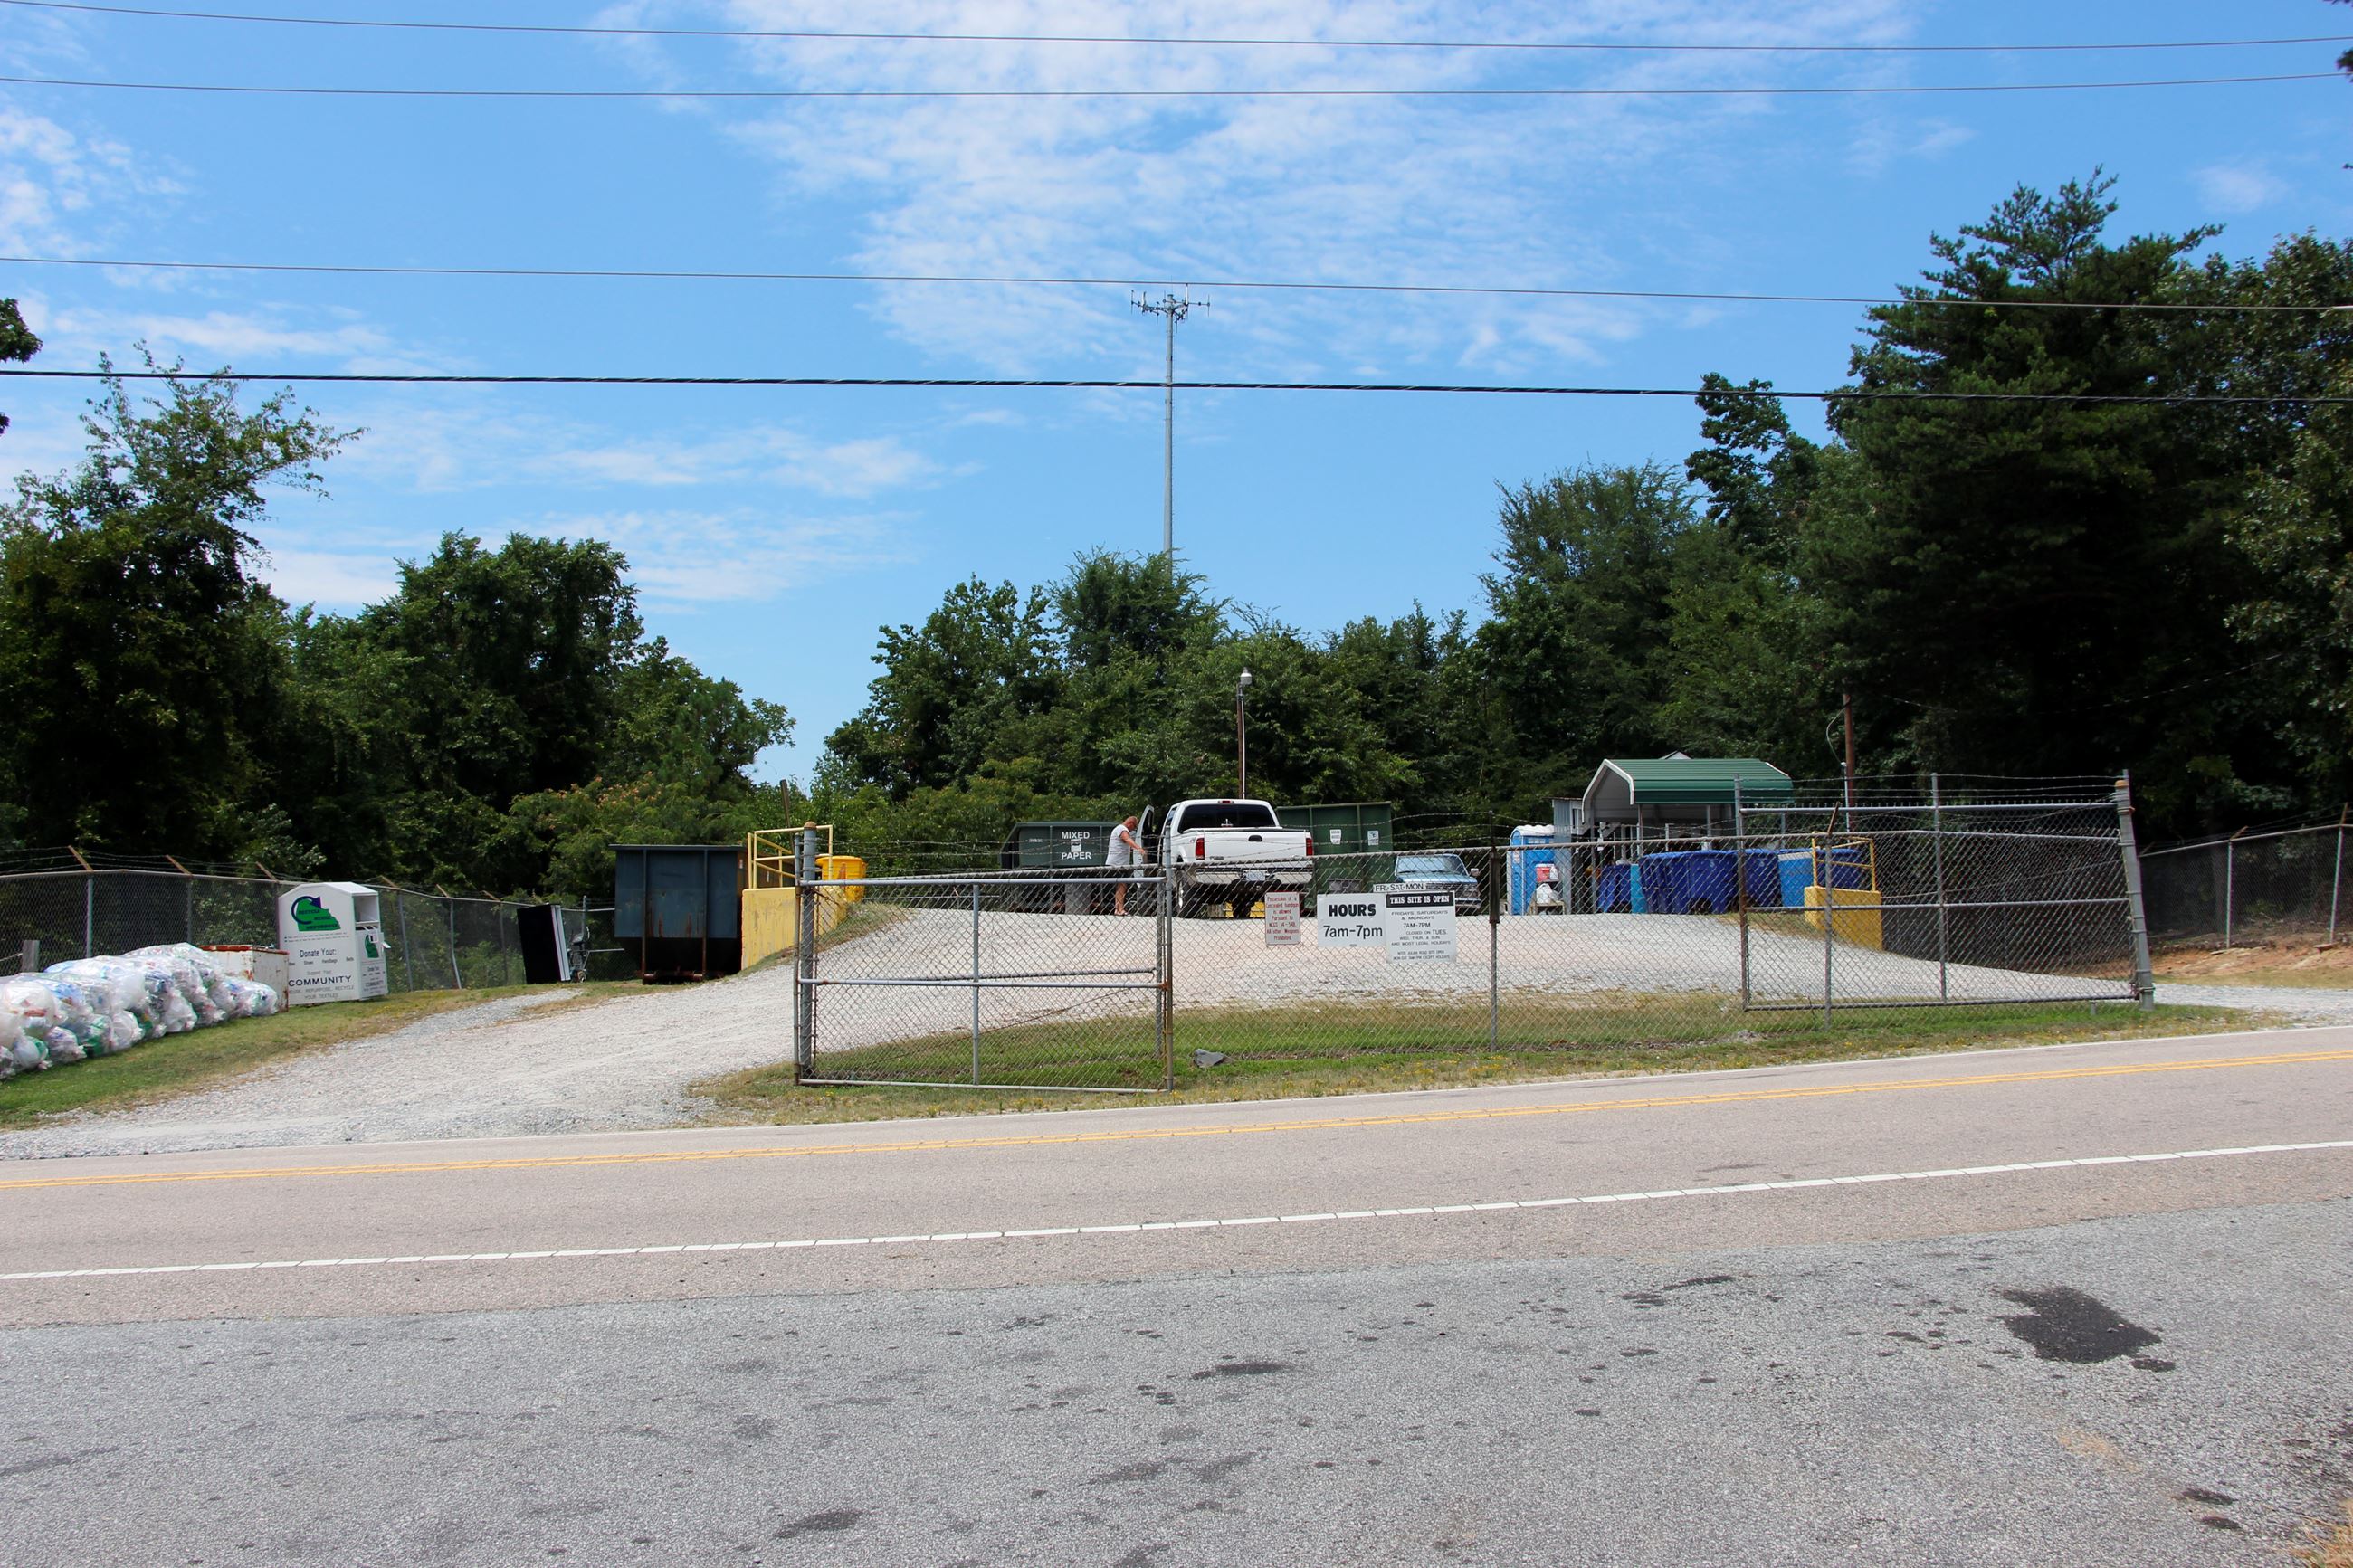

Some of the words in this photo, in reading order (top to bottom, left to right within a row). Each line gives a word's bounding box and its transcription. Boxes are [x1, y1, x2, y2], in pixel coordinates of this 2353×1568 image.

[1061, 851, 1091, 860] PAPER
[1433, 895, 1450, 903] OPEN
[1329, 904, 1377, 917] HOURS
[1323, 925, 1383, 939] 7am-7pm
[300, 949, 319, 957] Donate
[288, 975, 352, 987] COMMUNITY
